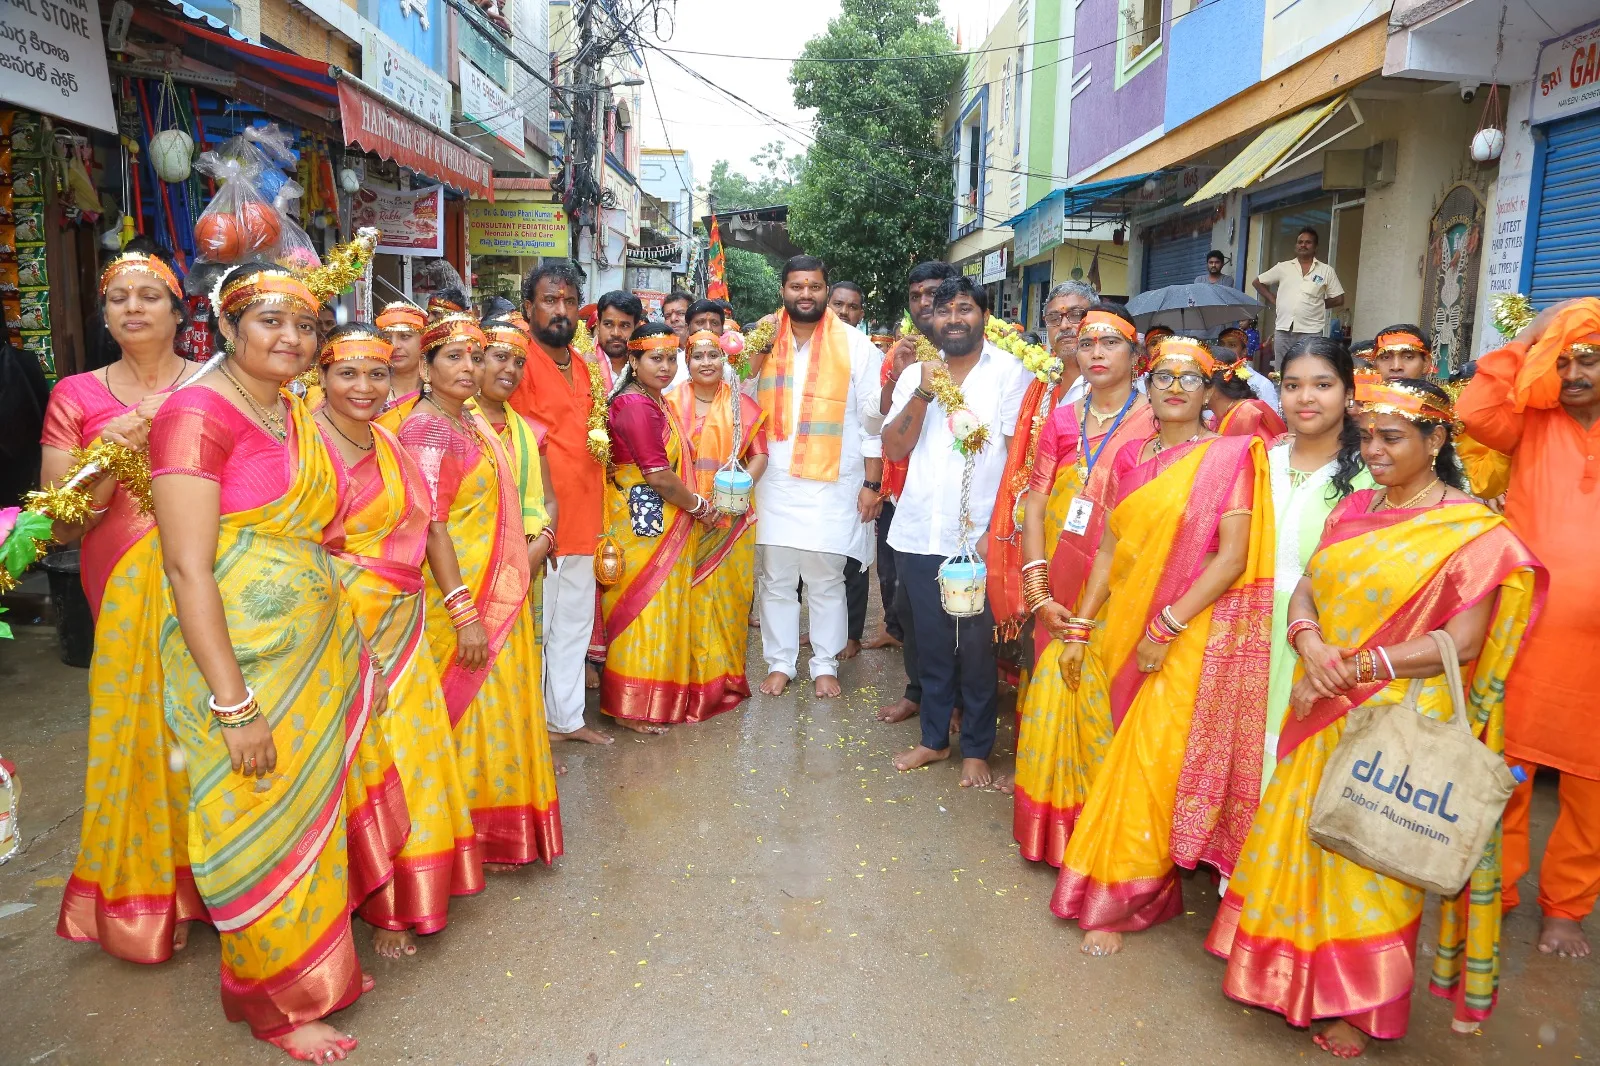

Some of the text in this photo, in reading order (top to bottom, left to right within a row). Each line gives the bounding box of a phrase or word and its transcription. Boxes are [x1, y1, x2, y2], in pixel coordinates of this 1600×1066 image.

[40, 0, 91, 39] STORE
[1541, 65, 1562, 96] SRI
[501, 209, 517, 218] Durga
[517, 209, 533, 218] Phani
[535, 210, 553, 218] Kumar
[471, 222, 566, 231] CONSULTANT PEDIATRICIAN
[1498, 220, 1522, 235] LATEST
[1491, 236, 1523, 251] HAIR STYLES
[1488, 261, 1520, 276] ALL TYPES OF
[1490, 279, 1512, 291] FACIALS
[1351, 750, 1459, 823] dubal
[1341, 786, 1451, 846] Dubai Aluminium
